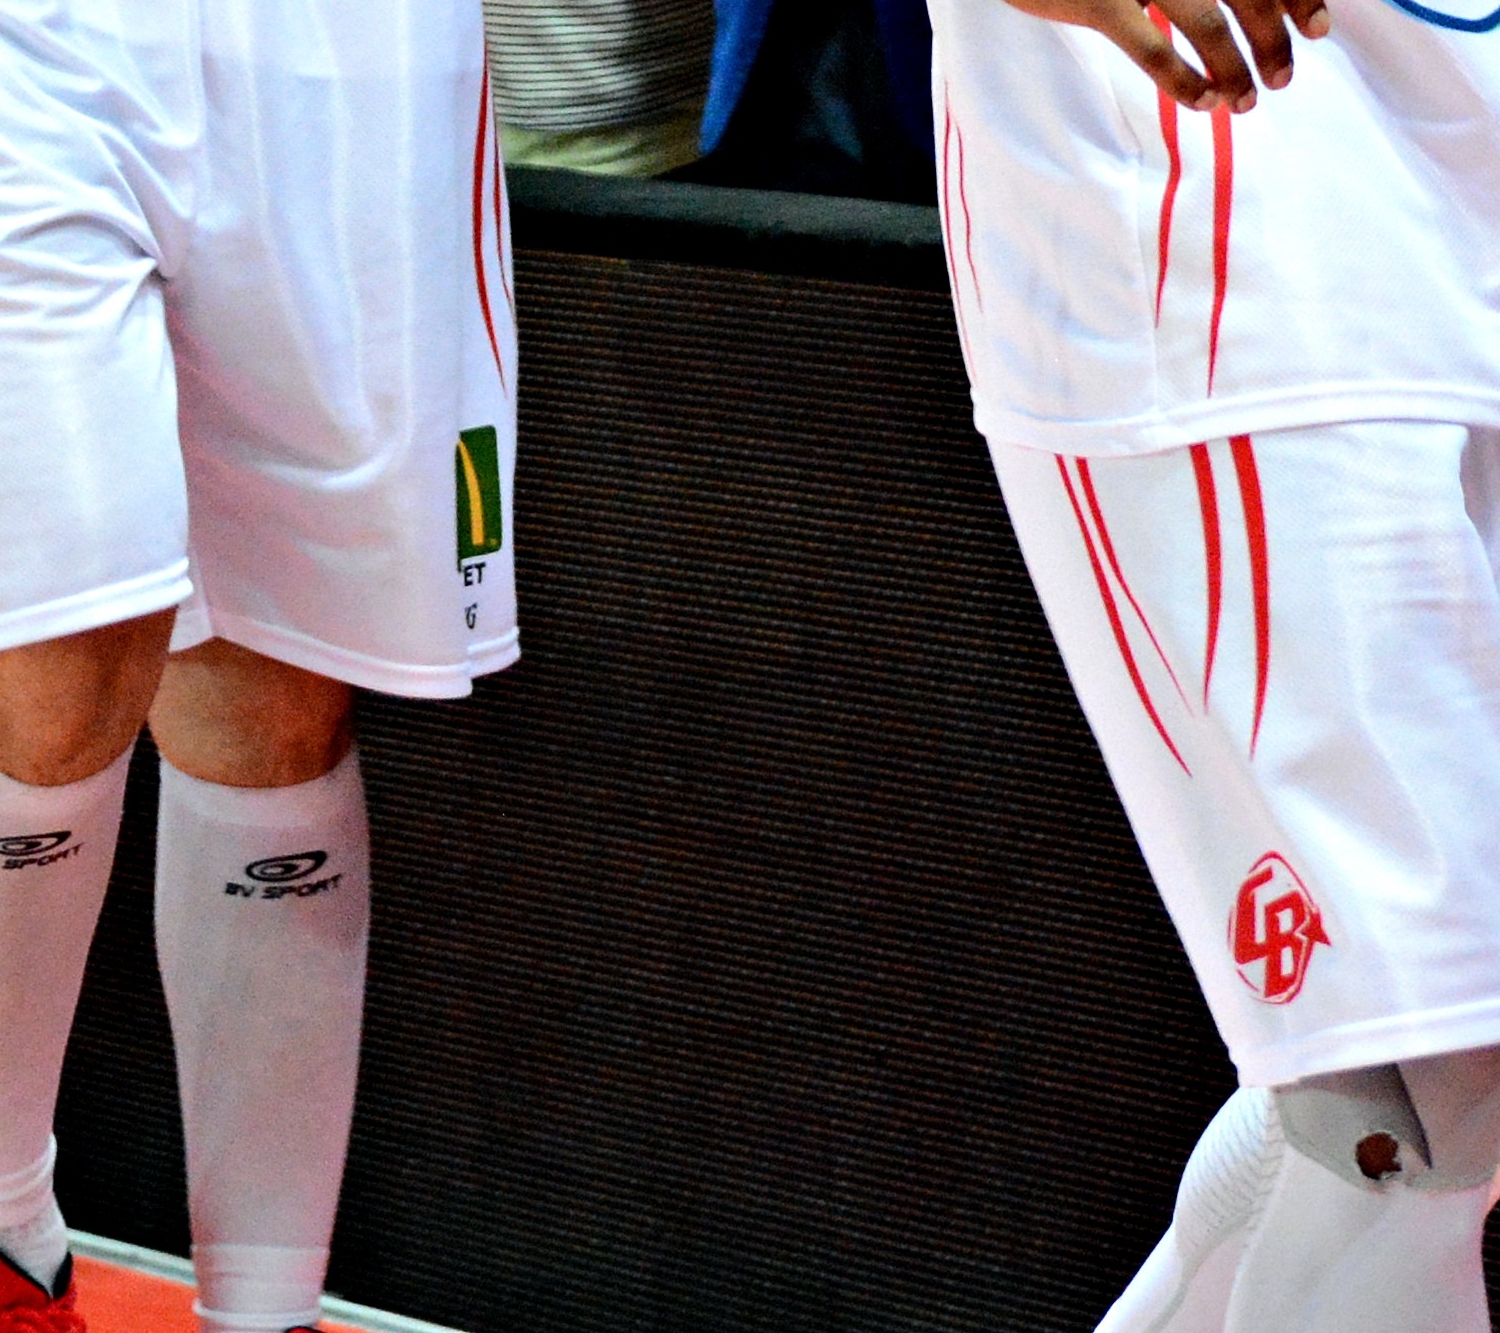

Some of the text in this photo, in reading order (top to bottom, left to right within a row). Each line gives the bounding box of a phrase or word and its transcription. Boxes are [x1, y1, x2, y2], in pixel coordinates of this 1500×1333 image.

[1, 842, 84, 871] SPORT
[225, 873, 343, 900] BV SPORT
